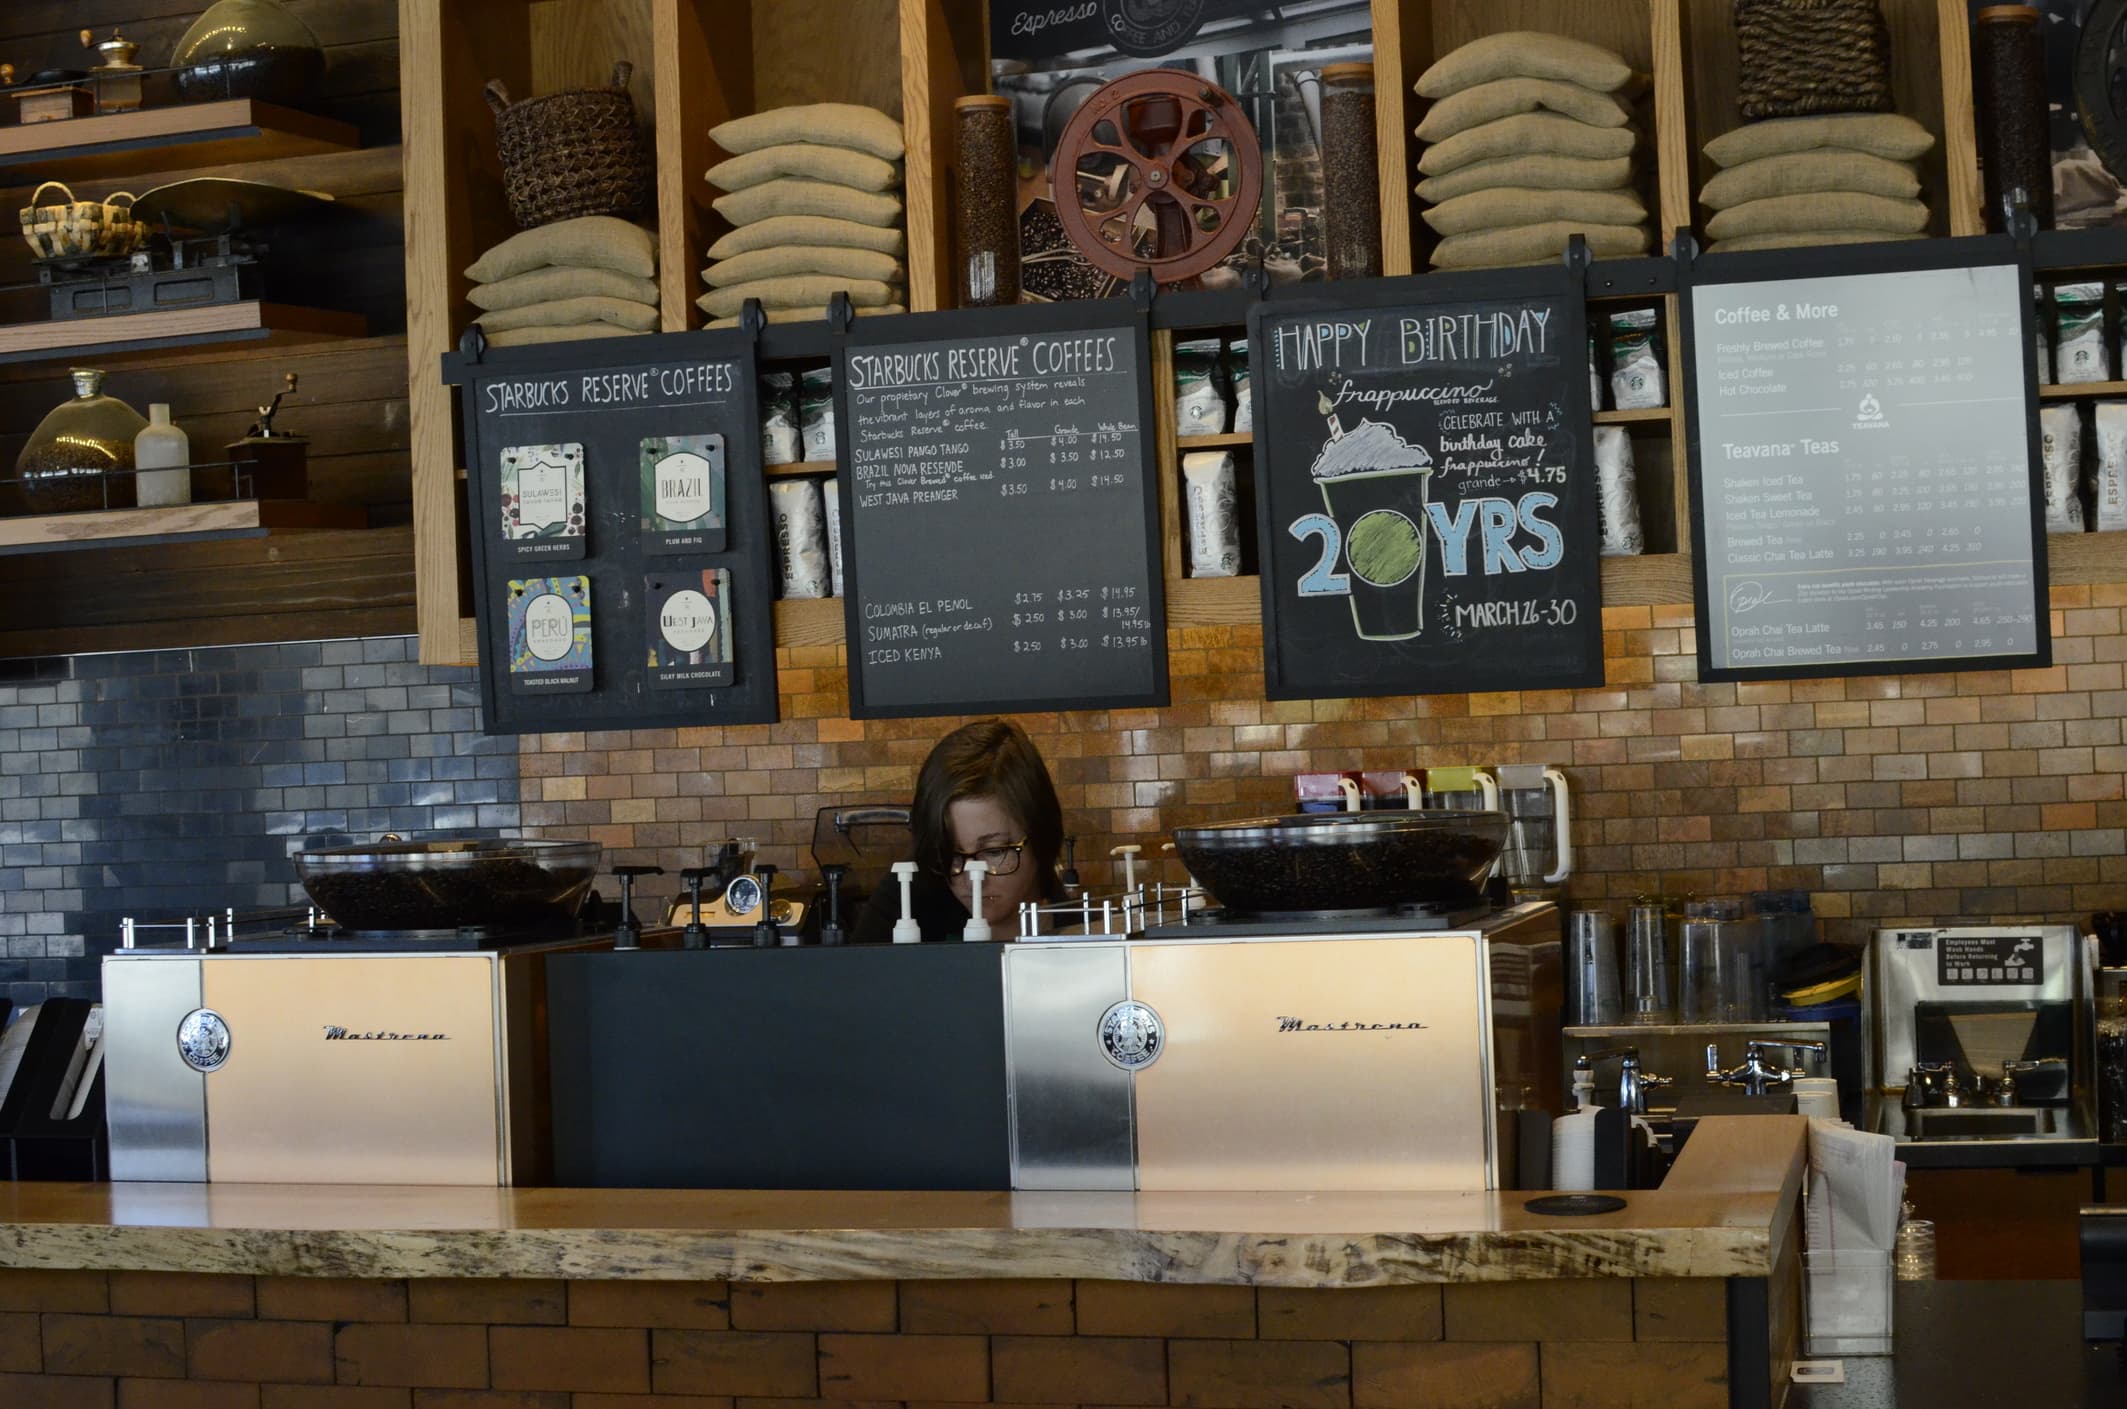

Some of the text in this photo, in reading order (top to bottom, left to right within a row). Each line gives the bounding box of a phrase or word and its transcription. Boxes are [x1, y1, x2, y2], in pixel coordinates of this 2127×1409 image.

[1011, 2, 1097, 36] Espresso
[1714, 303, 1839, 324] Coffee & More
[1274, 308, 1551, 370] HAPPY BIRTHDAY
[850, 352, 939, 387] STARBUCKS
[1033, 338, 1116, 374] COFFEES
[485, 380, 569, 413] STARBUCKS
[660, 363, 733, 397] COFFEES
[856, 394, 876, 404] Our
[973, 384, 1009, 400] brewing
[1016, 381, 1048, 397] system
[1054, 377, 1086, 388] reveals
[1332, 379, 1493, 412] frappuccino
[1719, 383, 1787, 397] Hot Chocolate
[915, 408, 940, 423] layers
[945, 404, 956, 416] of
[959, 406, 991, 415] aroma
[997, 402, 1014, 412] and
[1019, 399, 1046, 409] flavor
[1050, 398, 1059, 406] in
[1064, 396, 1086, 406] each
[1443, 410, 1554, 430] CELEBRATE WITH A
[860, 429, 904, 443] Starbucks
[954, 419, 987, 432] coffee
[1005, 428, 1020, 439] Tall
[1054, 424, 1080, 435] Grande
[855, 446, 903, 463] SULAWESI
[908, 445, 938, 458] PANGO
[940, 443, 969, 455] TANGO
[1440, 427, 1547, 460] birthday cake
[1800, 439, 1839, 455] Teas
[856, 465, 889, 480] BRAZIL
[893, 463, 918, 476] NOVA
[920, 461, 964, 475] RESENDE
[661, 478, 704, 498] BRAZIL
[1458, 466, 1567, 495] grande $4.75
[522, 488, 562, 498] SULAWESI
[859, 492, 883, 508] WEST
[886, 491, 910, 505] JAVA
[913, 489, 959, 504] PREANGER
[1770, 506, 1820, 518] Lemonade
[1423, 492, 1564, 577] YRS
[1728, 536, 1763, 548] Brewed
[1767, 535, 1783, 545] Tea
[1809, 549, 1834, 559] Latte
[865, 602, 914, 619] COLOMBIA
[919, 601, 933, 615] EL
[1456, 599, 1577, 627] MARCH 26-30
[690, 614, 714, 629] JAVA
[1731, 622, 1830, 638] Oprah Chai Tea Latte
[868, 624, 919, 642] SUMATRA
[868, 649, 900, 664] ICED
[905, 646, 942, 662] KENYA
[1733, 648, 1760, 660] Oprah
[1763, 646, 1785, 657] Chai
[1787, 645, 1822, 656] Brewed
[1824, 643, 1841, 654] Tea
[323, 1025, 452, 1041] Mastrena
[1276, 1016, 1429, 1032] Mastrena
